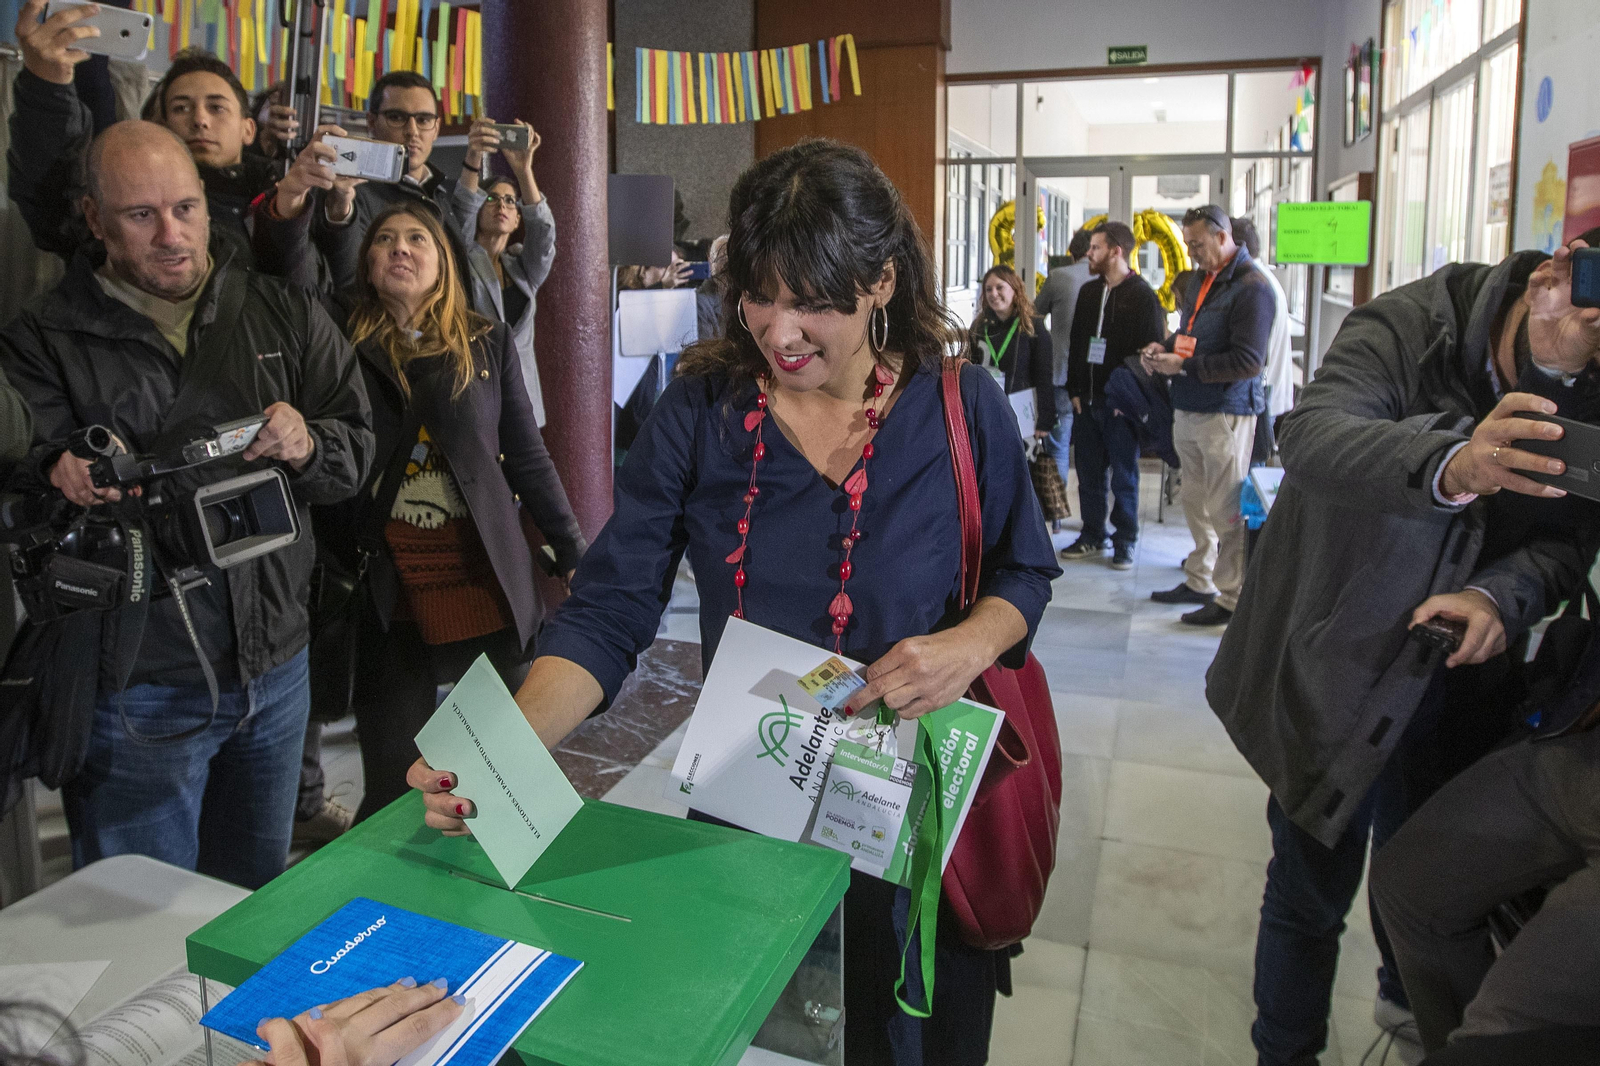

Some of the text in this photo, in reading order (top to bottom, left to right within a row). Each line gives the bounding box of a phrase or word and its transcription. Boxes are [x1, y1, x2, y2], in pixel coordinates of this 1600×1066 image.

[1117, 50, 1146, 60] SALIDA
[129, 528, 145, 603] Panasonic
[55, 580, 98, 597] Panasonic
[169, 577, 200, 649] Panasonic
[474, 736, 481, 747] DE
[789, 706, 833, 792] Adelante
[840, 748, 889, 773] Interventor/a
[478, 746, 506, 791] PARLAMENTO
[686, 753, 700, 781] ELECCIONES
[808, 726, 844, 804] ANDALUC
[943, 731, 979, 809] electoral
[505, 788, 513, 798] AL
[861, 791, 901, 811] Adelante
[511, 797, 541, 840] ELECCIONES
[310, 914, 387, 975] Cuaderno
